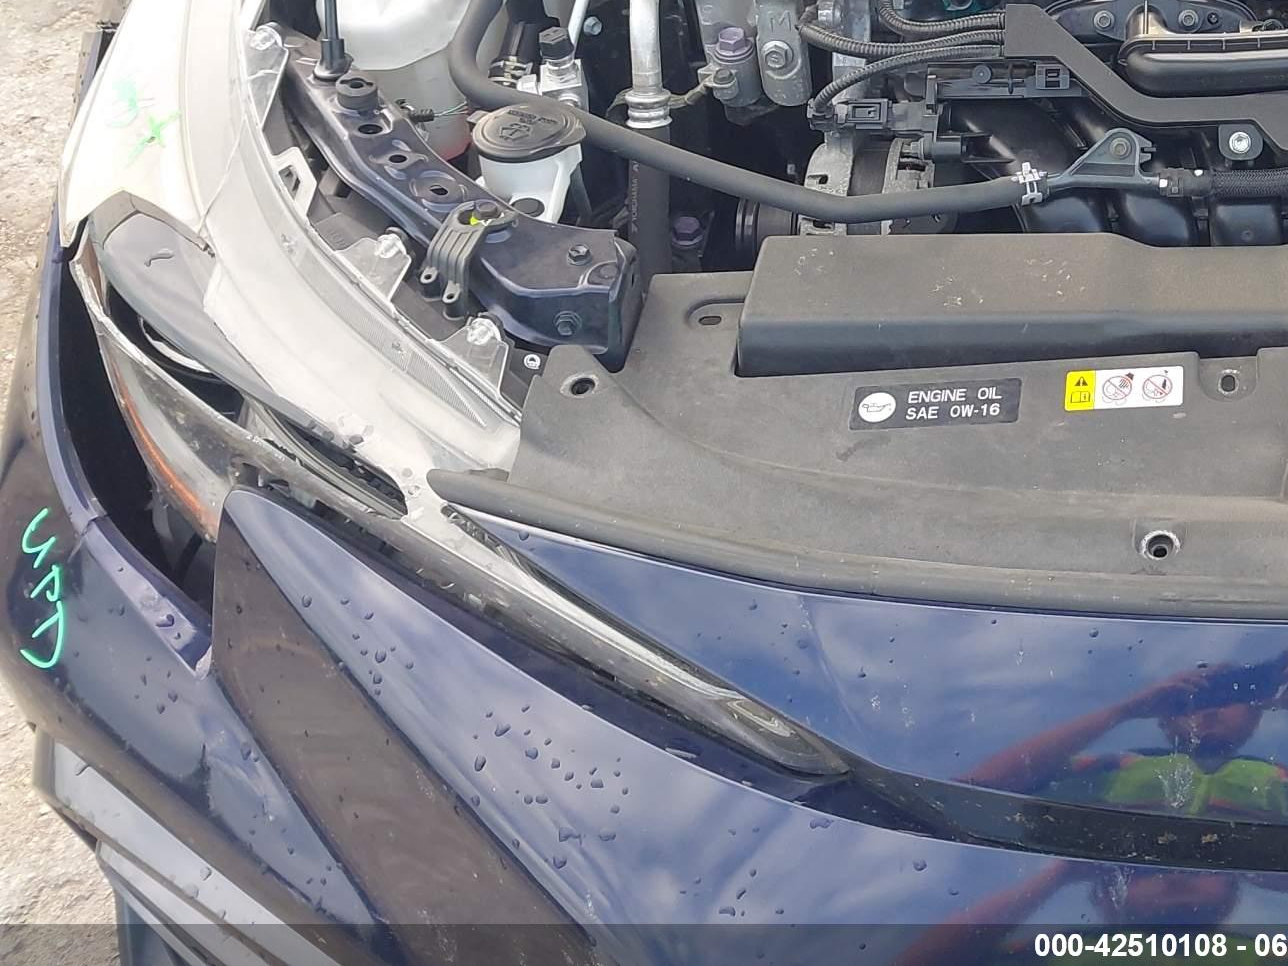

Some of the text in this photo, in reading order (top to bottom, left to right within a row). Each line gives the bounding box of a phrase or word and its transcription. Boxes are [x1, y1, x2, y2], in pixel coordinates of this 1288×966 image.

[907, 386, 1003, 404] ENGINE OIL
[905, 405, 940, 420] SAE
